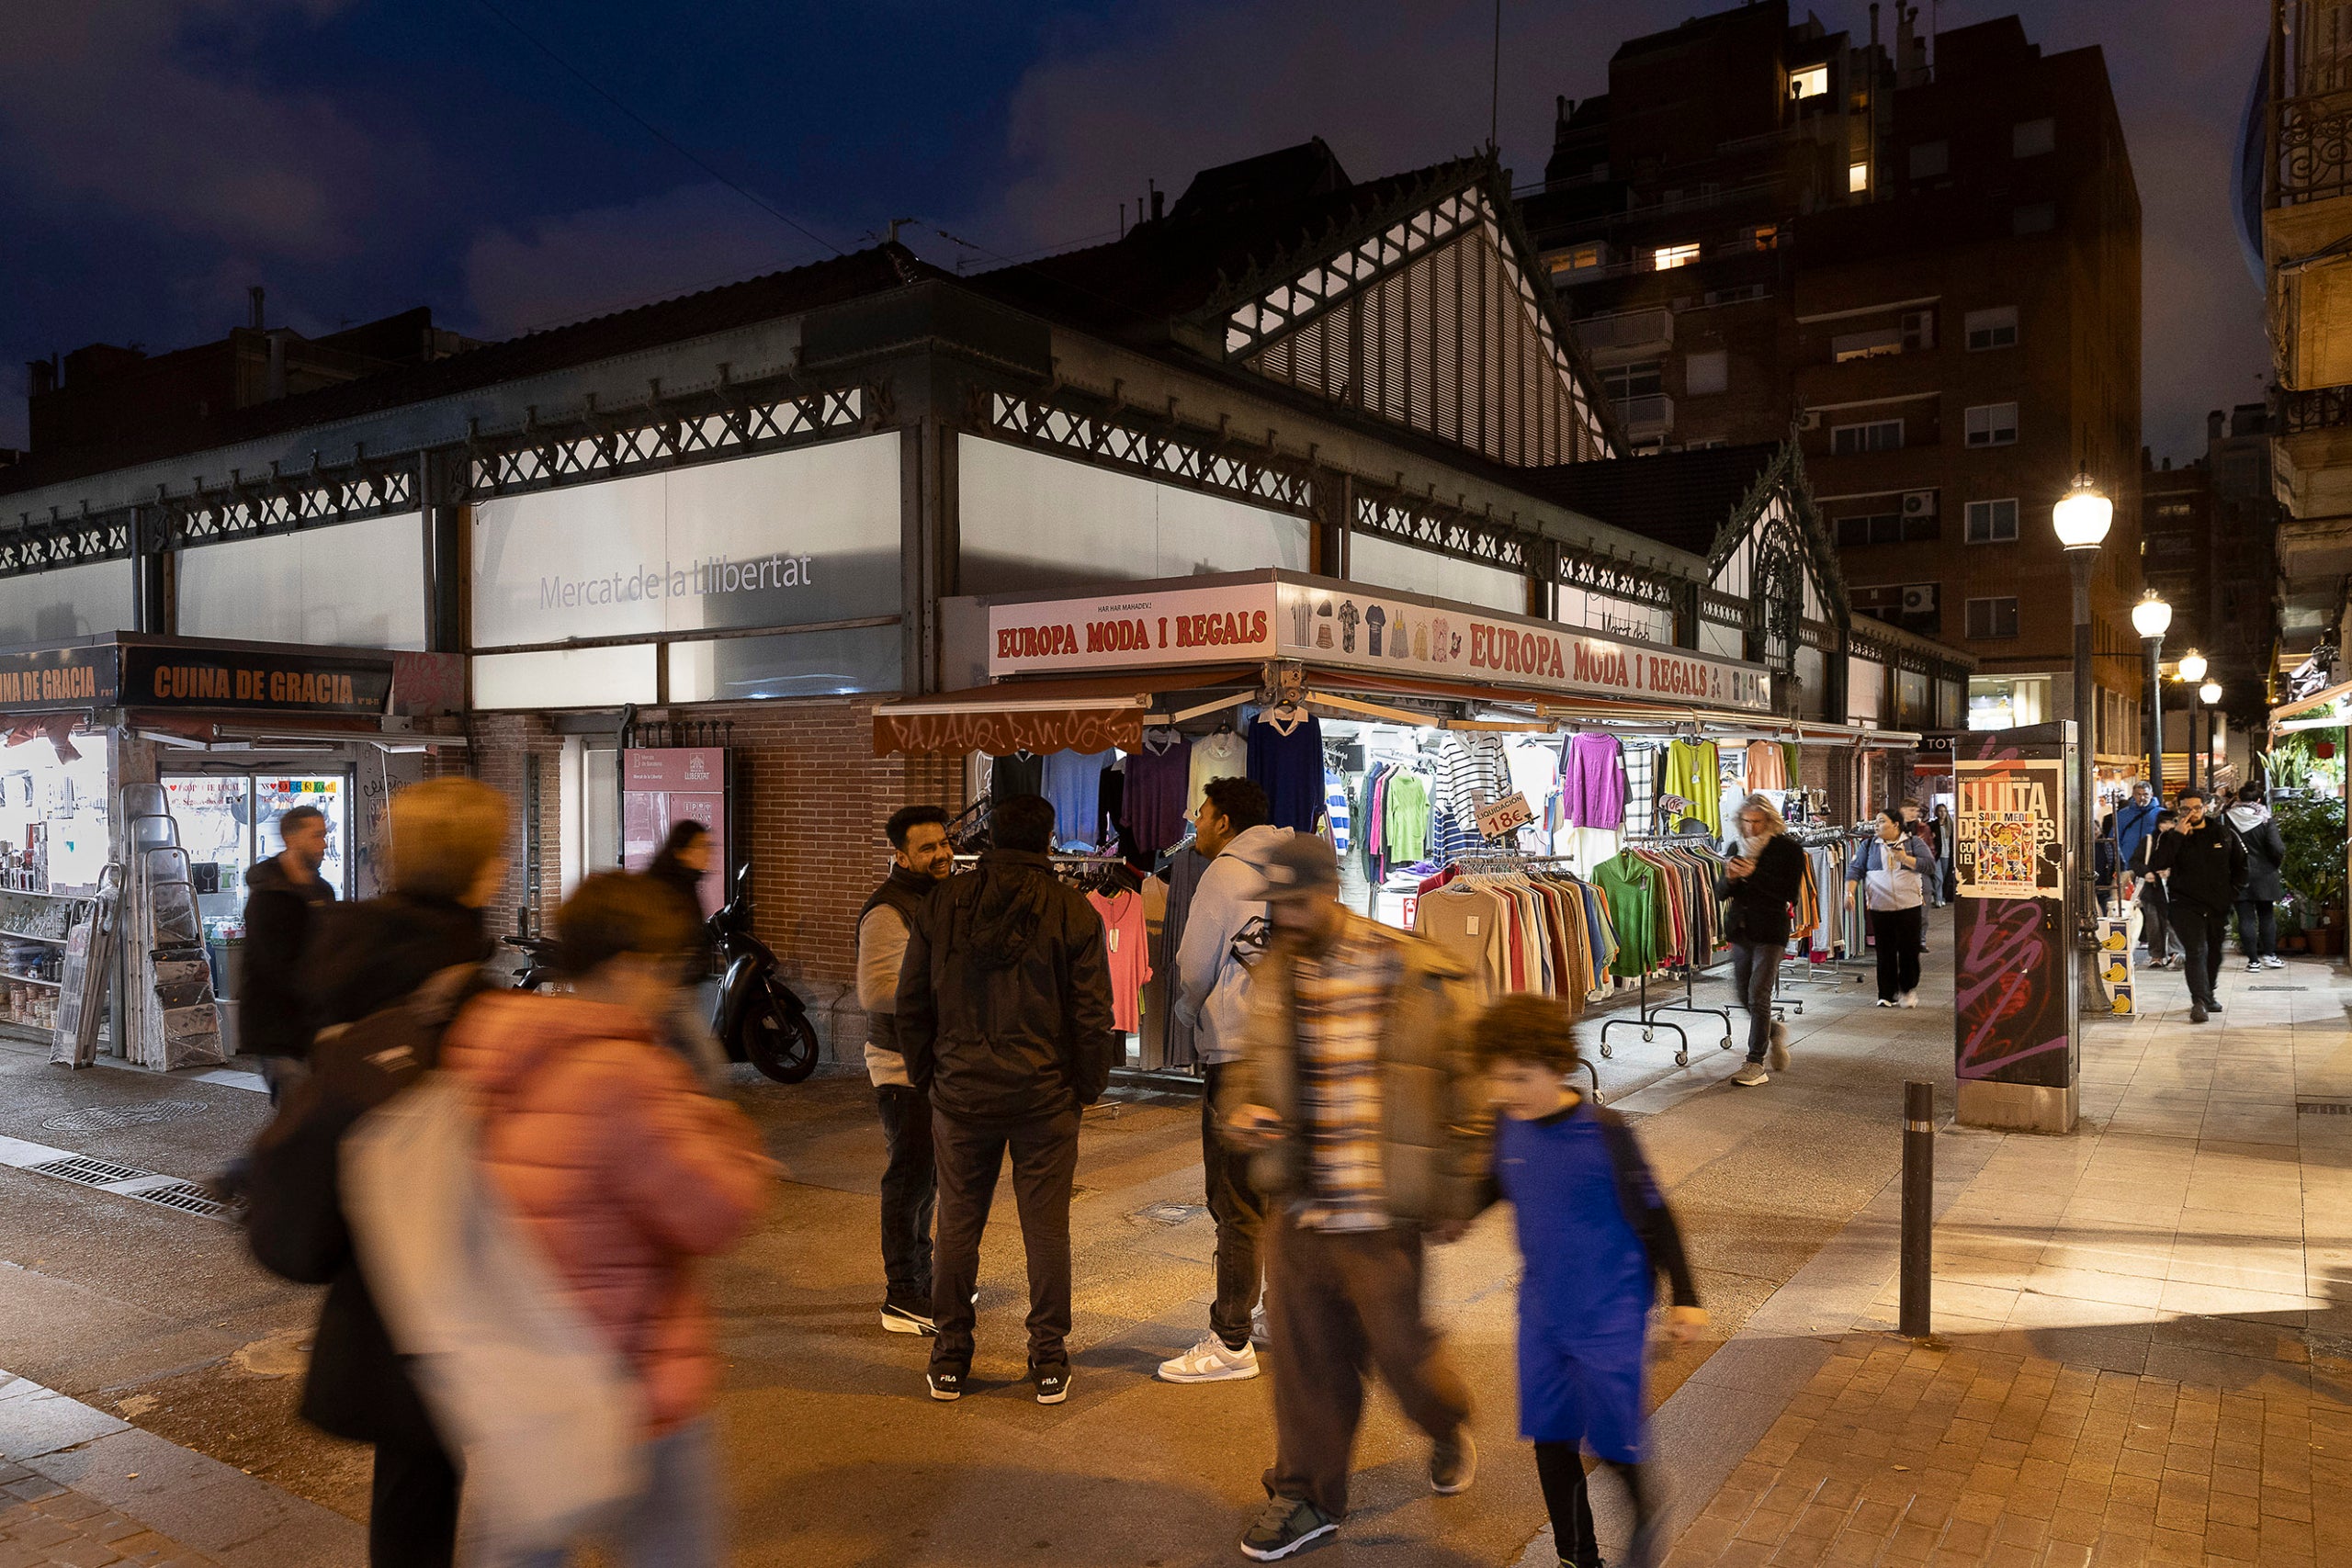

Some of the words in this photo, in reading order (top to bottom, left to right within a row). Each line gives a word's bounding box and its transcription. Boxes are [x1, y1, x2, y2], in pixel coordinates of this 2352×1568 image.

[540, 571, 622, 609] Mercat
[628, 564, 660, 601] de
[665, 561, 686, 597] la
[694, 551, 811, 595] Llibertat
[997, 624, 1079, 658] EUROPA
[1086, 618, 1150, 653] MODA
[1158, 617, 1168, 649] I
[1175, 610, 1267, 648] REGALS
[1470, 623, 1565, 678] EUROPA
[1574, 642, 1629, 688] MODA
[1635, 654, 1643, 689] I
[1649, 656, 1707, 697] REGALS
[23, 671, 40, 701] DE
[42, 666, 96, 701] GRACIA
[154, 665, 231, 699] CUINA
[236, 669, 265, 701] DE
[270, 671, 354, 704] GRACIA
[1477, 795, 1522, 819] LIQUIDACIÓN
[1958, 783, 2049, 818] LLUITA
[1978, 812, 2001, 821] SANT
[2005, 812, 2034, 821] MEDIR
[1488, 810, 1523, 832] 18€
[940, 1374, 956, 1382] FILA
